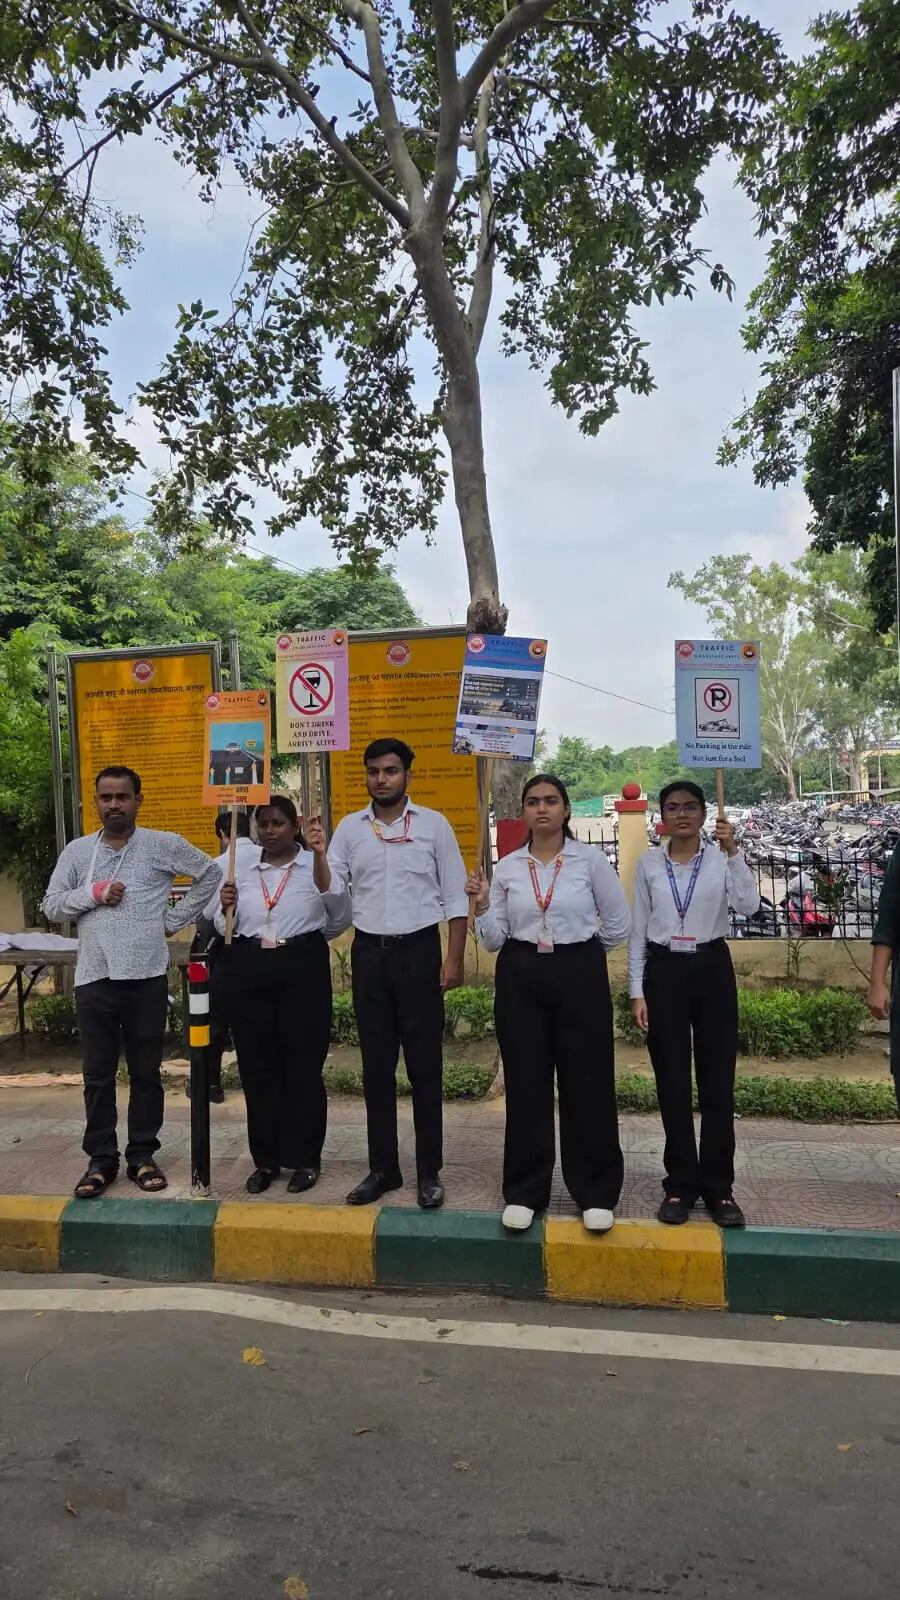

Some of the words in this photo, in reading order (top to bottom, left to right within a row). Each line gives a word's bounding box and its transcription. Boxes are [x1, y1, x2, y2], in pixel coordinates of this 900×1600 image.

[297, 635, 326, 643] TRAFFIC
[491, 639, 527, 647] TRAFFIC
[290, 721, 311, 729] DON'T
[312, 720, 335, 728] DRINK
[288, 740, 312, 748] ARRIVE
[695, 742, 721, 750] Parking
[705, 754, 718, 763] just
[718, 754, 728, 762] for
